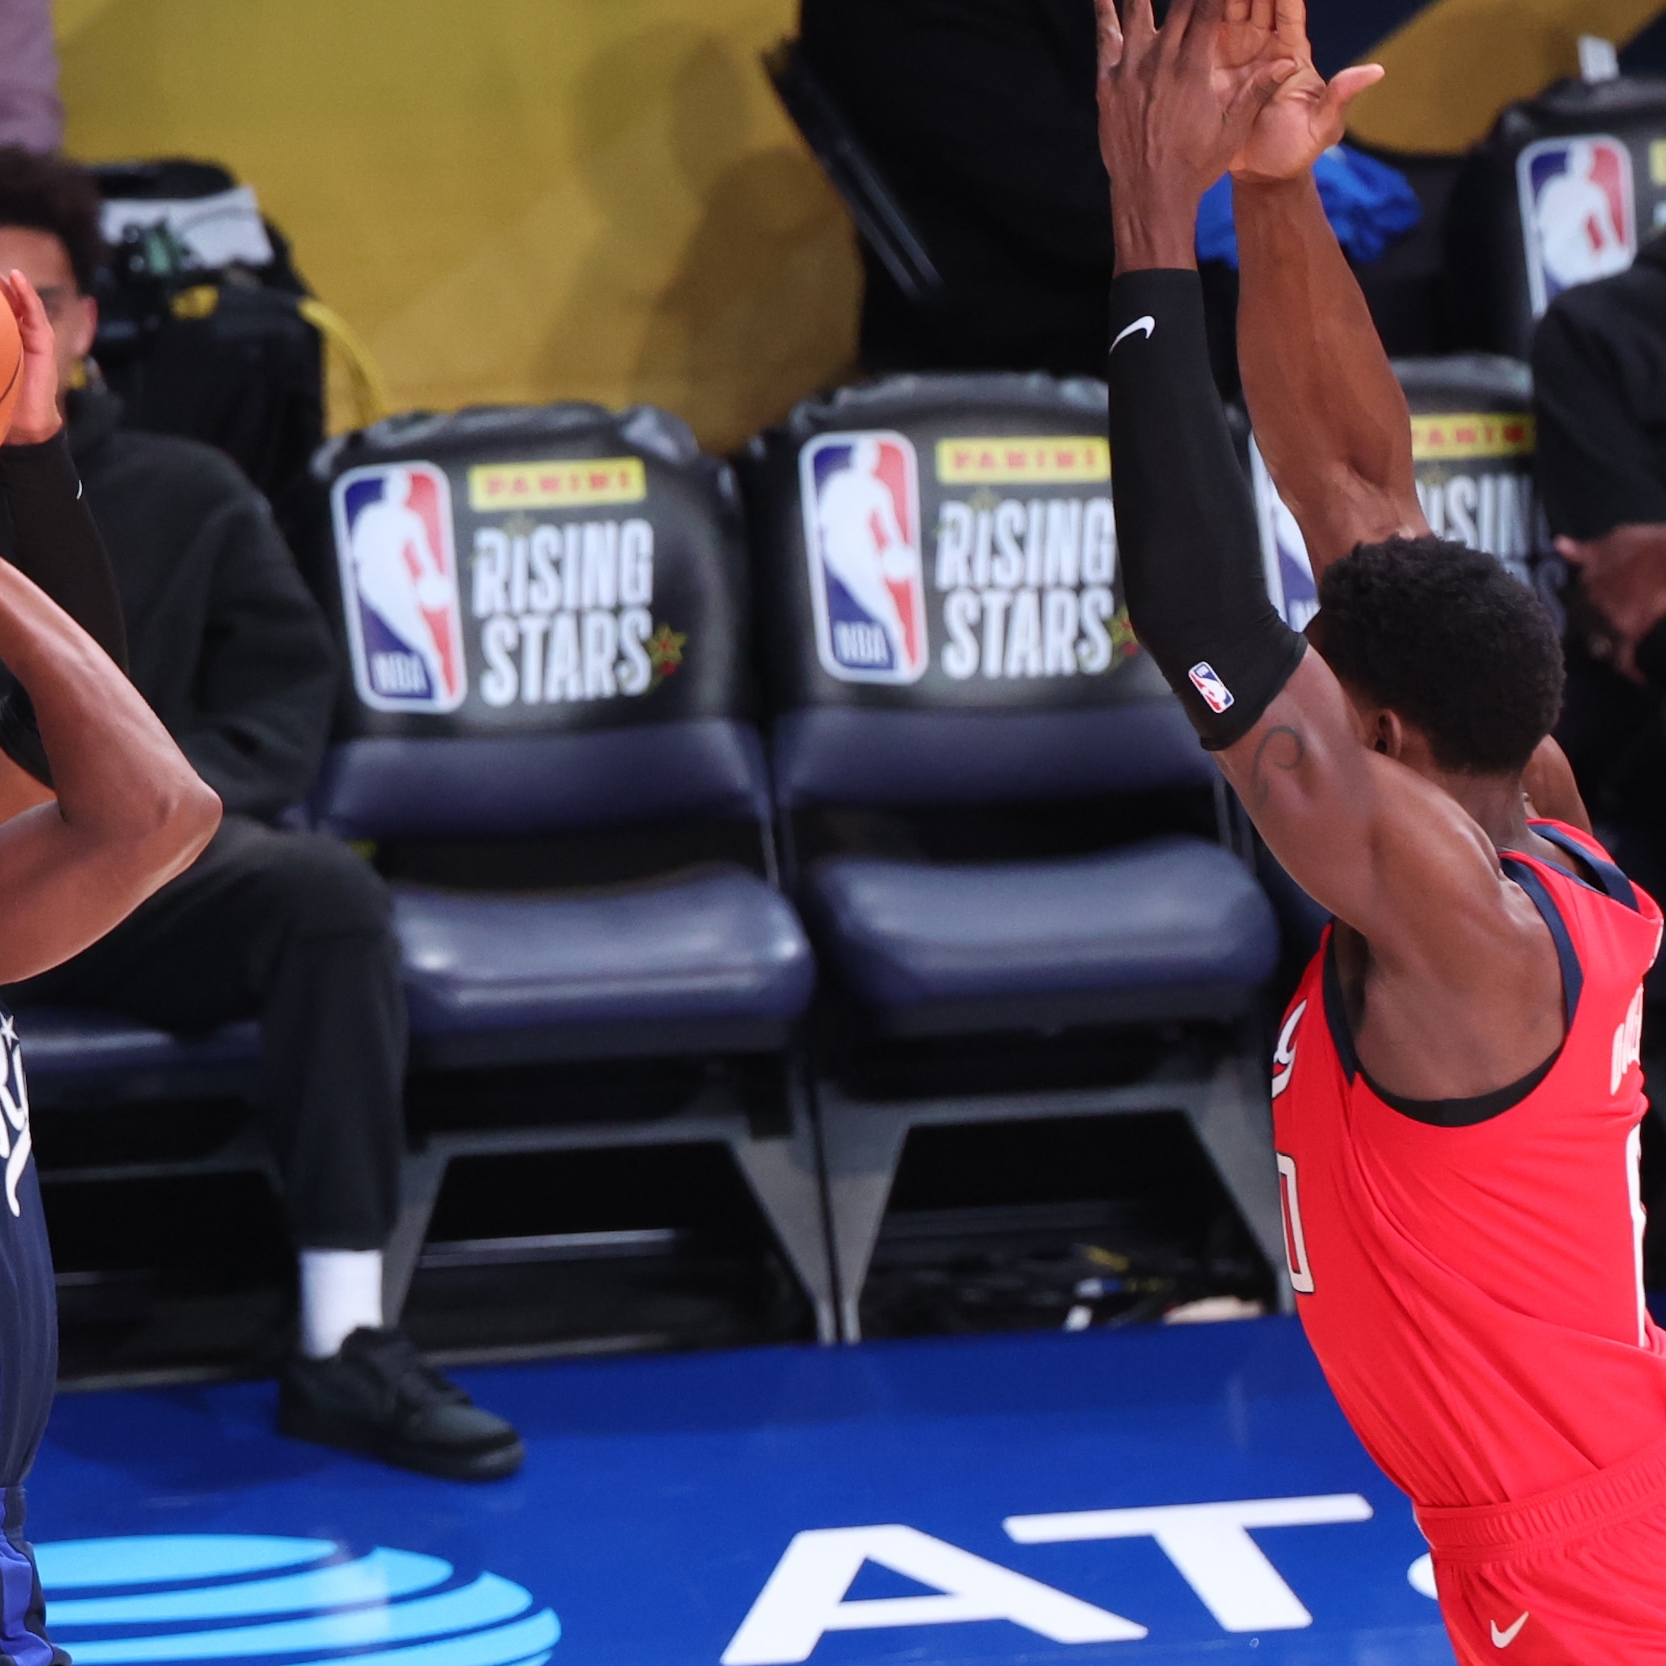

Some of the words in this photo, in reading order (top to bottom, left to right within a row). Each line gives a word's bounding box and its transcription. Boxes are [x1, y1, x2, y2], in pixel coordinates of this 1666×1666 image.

[472, 518, 654, 618] RISING
[936, 498, 1116, 591] RISING
[481, 607, 653, 706] STARS
[941, 587, 1114, 680] STARS
